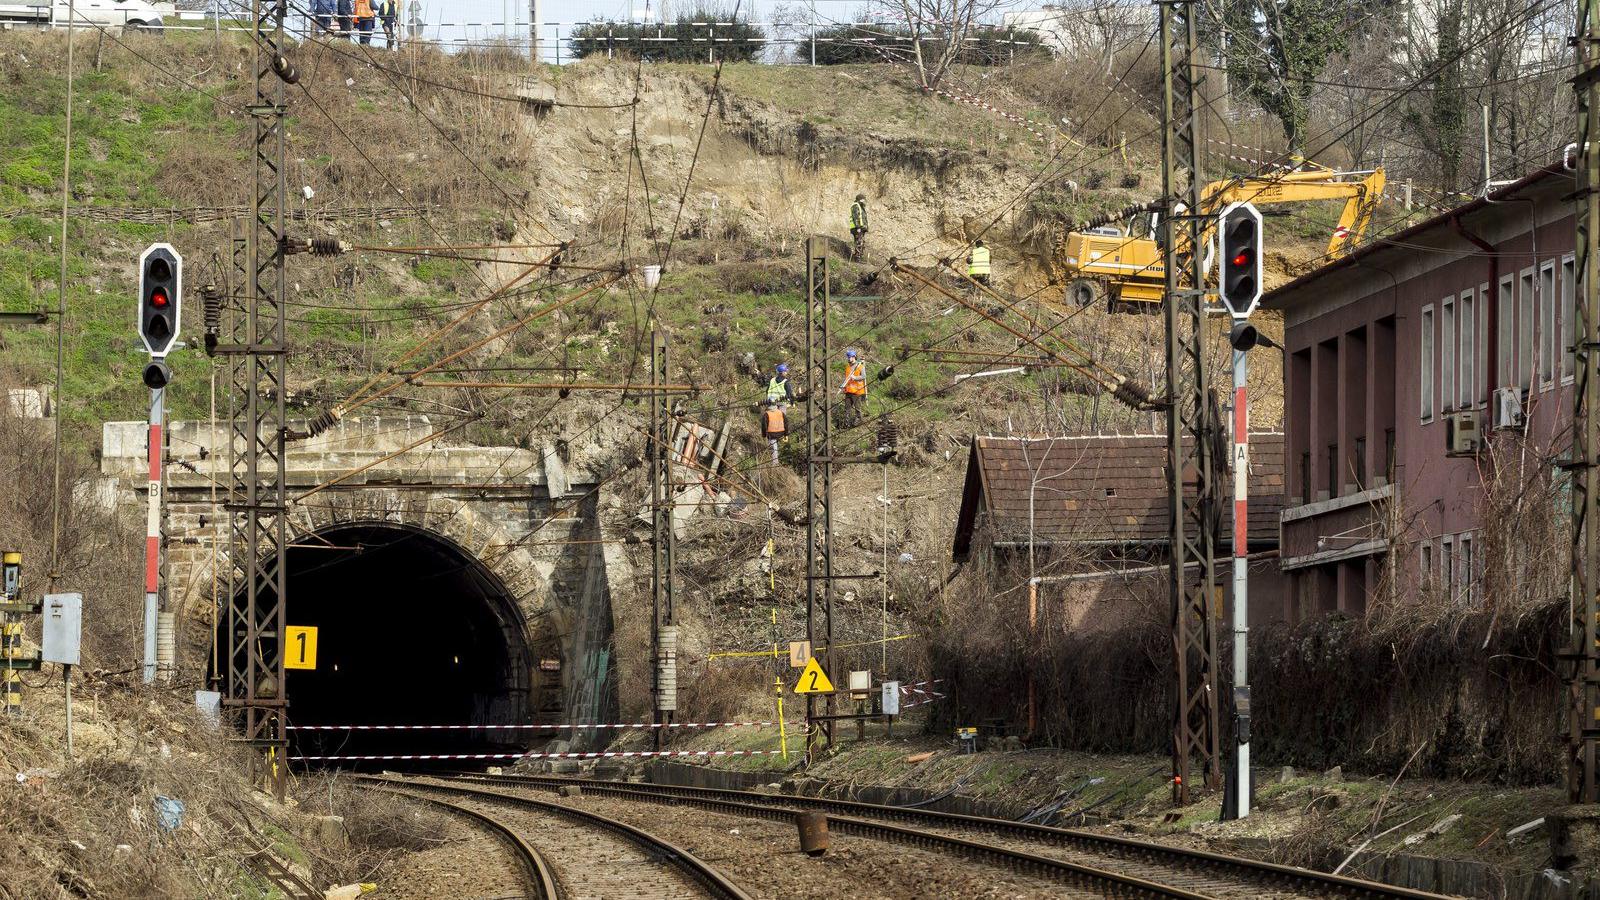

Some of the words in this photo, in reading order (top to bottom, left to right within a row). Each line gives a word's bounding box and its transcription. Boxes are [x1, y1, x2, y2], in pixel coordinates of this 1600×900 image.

[1238, 446, 1245, 460] A
[151, 483, 158, 496] B
[297, 632, 307, 663] 1
[797, 643, 806, 663] 4
[809, 670, 819, 691] 2
